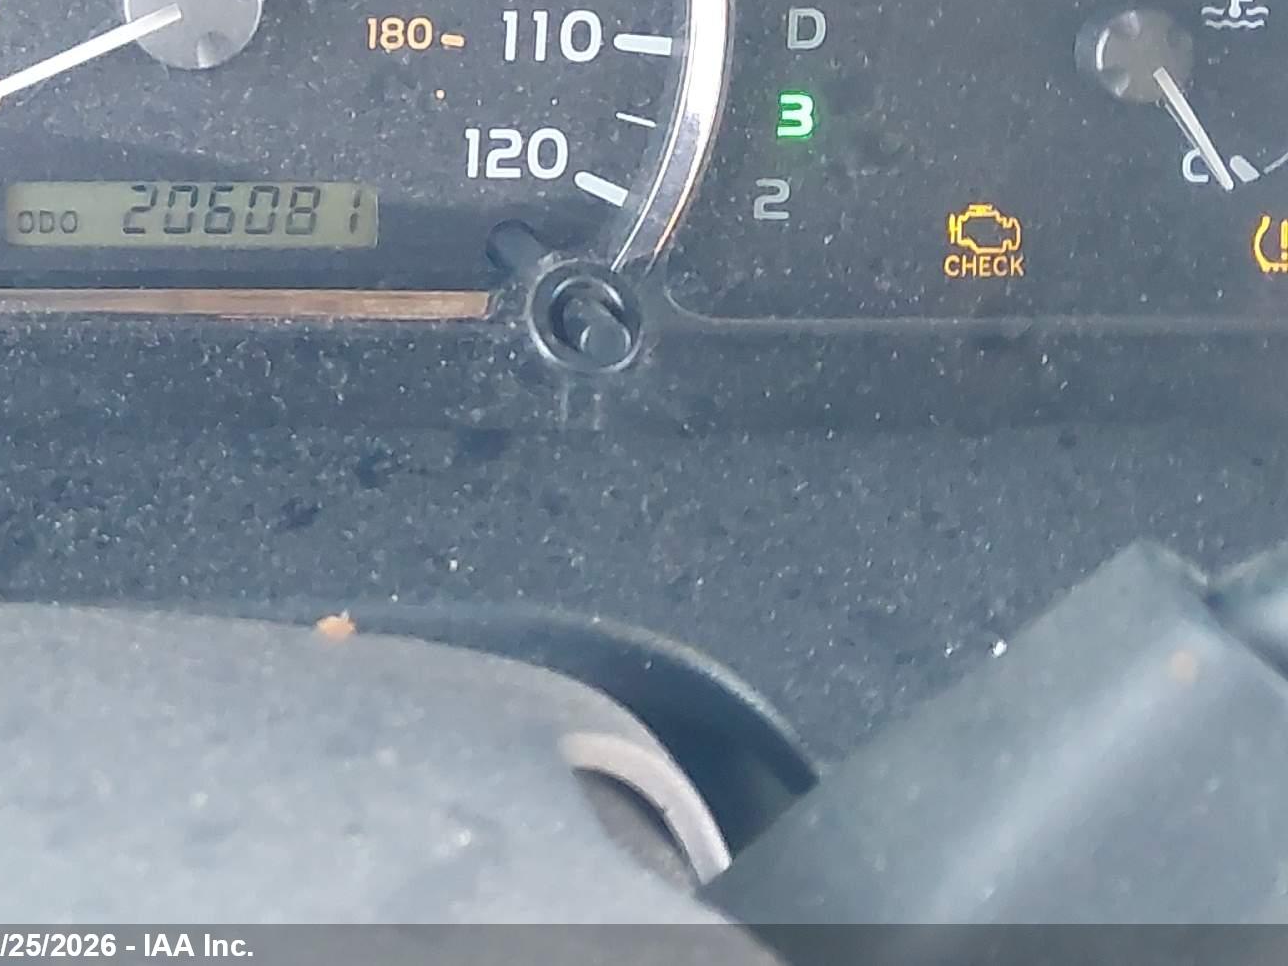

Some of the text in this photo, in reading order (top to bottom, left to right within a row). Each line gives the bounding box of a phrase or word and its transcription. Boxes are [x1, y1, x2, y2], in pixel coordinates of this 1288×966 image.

[367, 17, 434, 50] 180
[502, 9, 604, 62] 110
[786, 8, 827, 50] D
[777, 93, 814, 138] 3
[464, 127, 569, 180] 120
[1182, 148, 1209, 183] C
[17, 184, 361, 234] ODO 206081
[753, 178, 791, 221] 2
[943, 256, 1025, 278] CHECK
